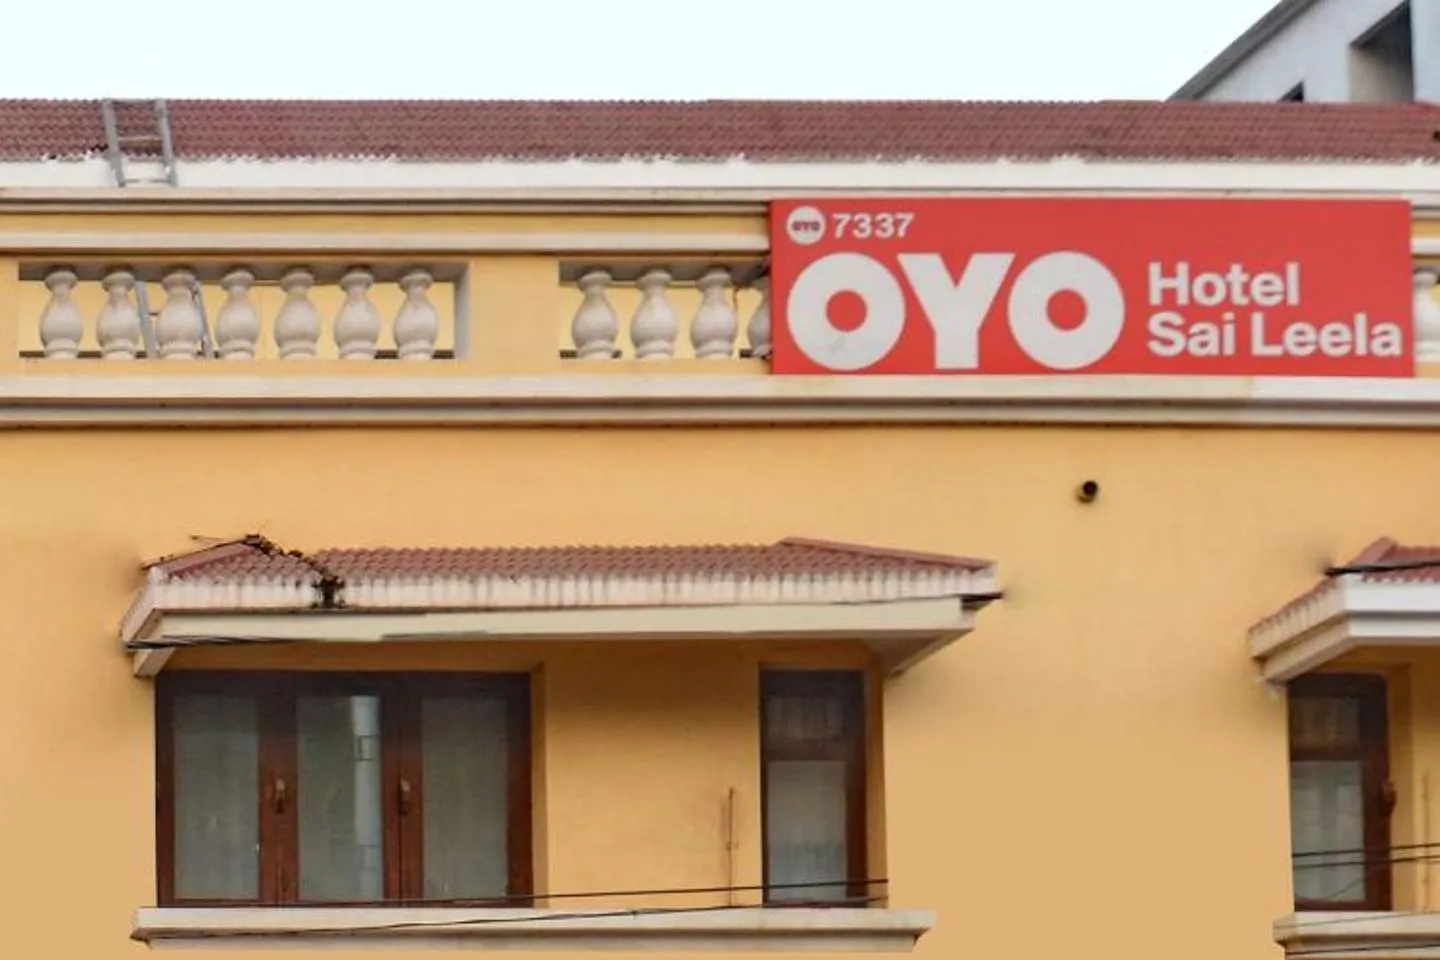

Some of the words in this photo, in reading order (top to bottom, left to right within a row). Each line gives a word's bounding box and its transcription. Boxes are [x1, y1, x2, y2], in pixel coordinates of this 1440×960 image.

[833, 212, 914, 239] 7337
[1148, 261, 1300, 306] Hotel
[786, 251, 1125, 370] OYO
[1147, 310, 1236, 357] Sai
[1251, 311, 1403, 357] Leela
